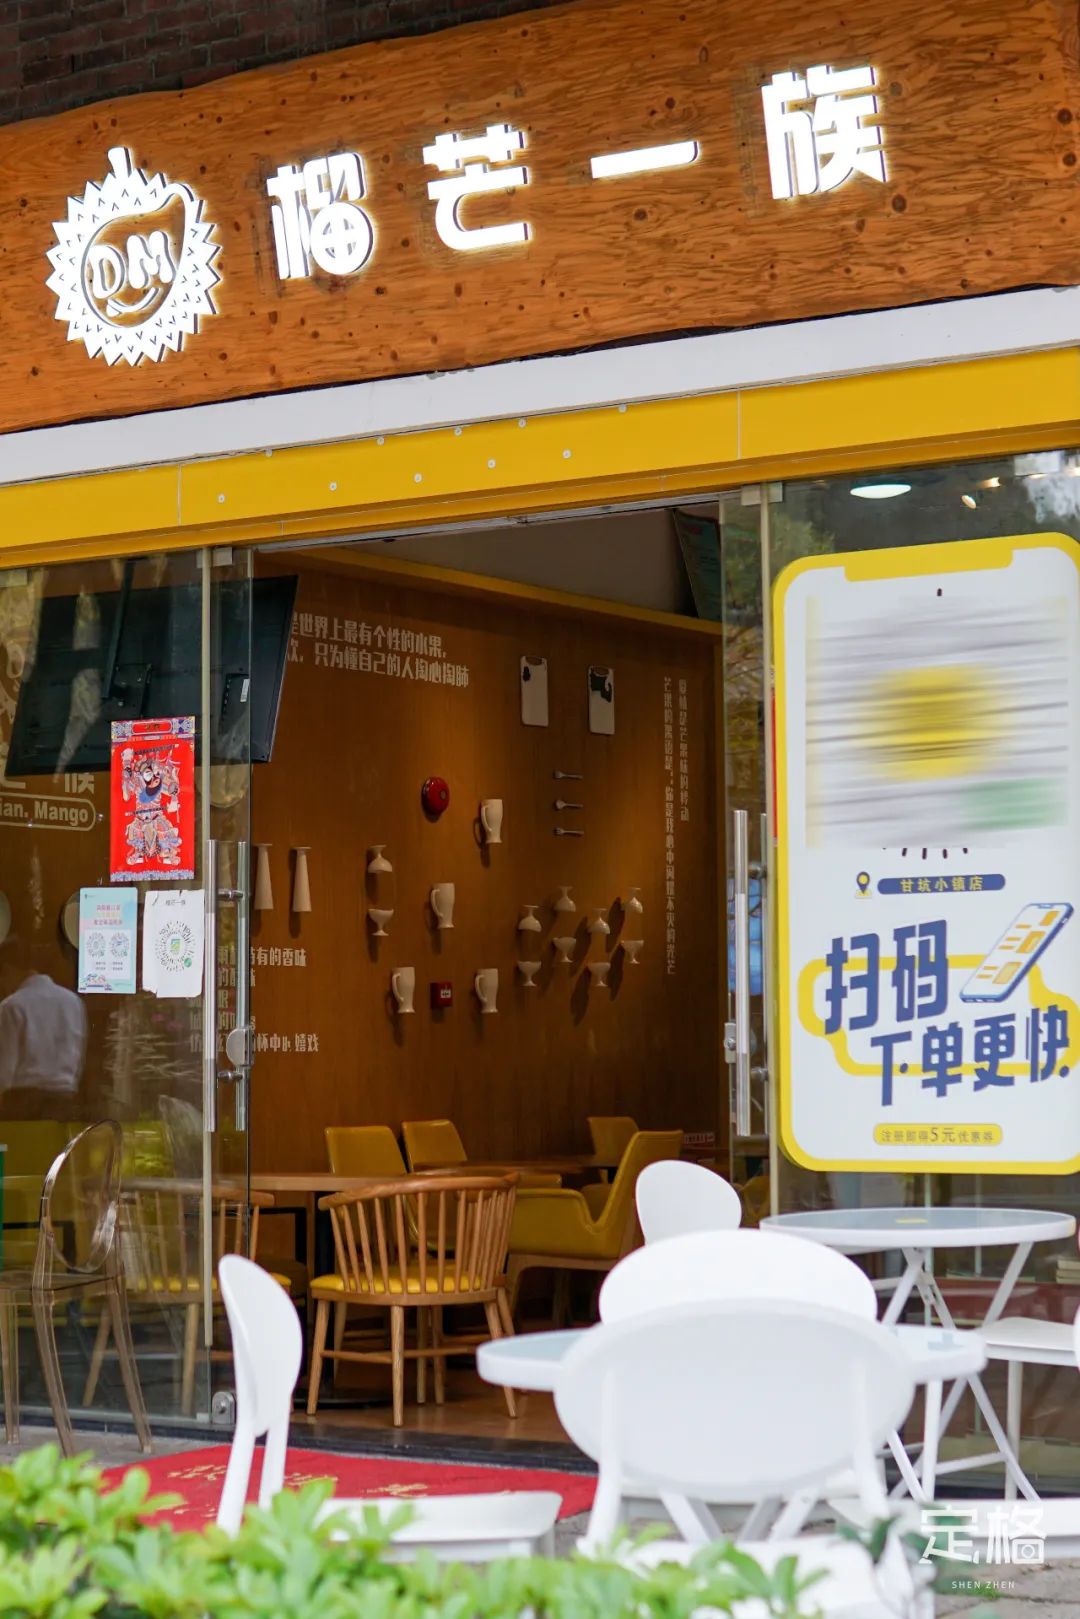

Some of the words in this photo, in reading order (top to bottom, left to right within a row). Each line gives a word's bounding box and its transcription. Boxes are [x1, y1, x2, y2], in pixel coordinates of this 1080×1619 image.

[88, 230, 176, 299] DM
[34, 801, 89, 827] Mango
[900, 875, 984, 893] 甘坑小镇店
[824, 919, 949, 1035] 扫码
[870, 1003, 1071, 1107] 下单更快
